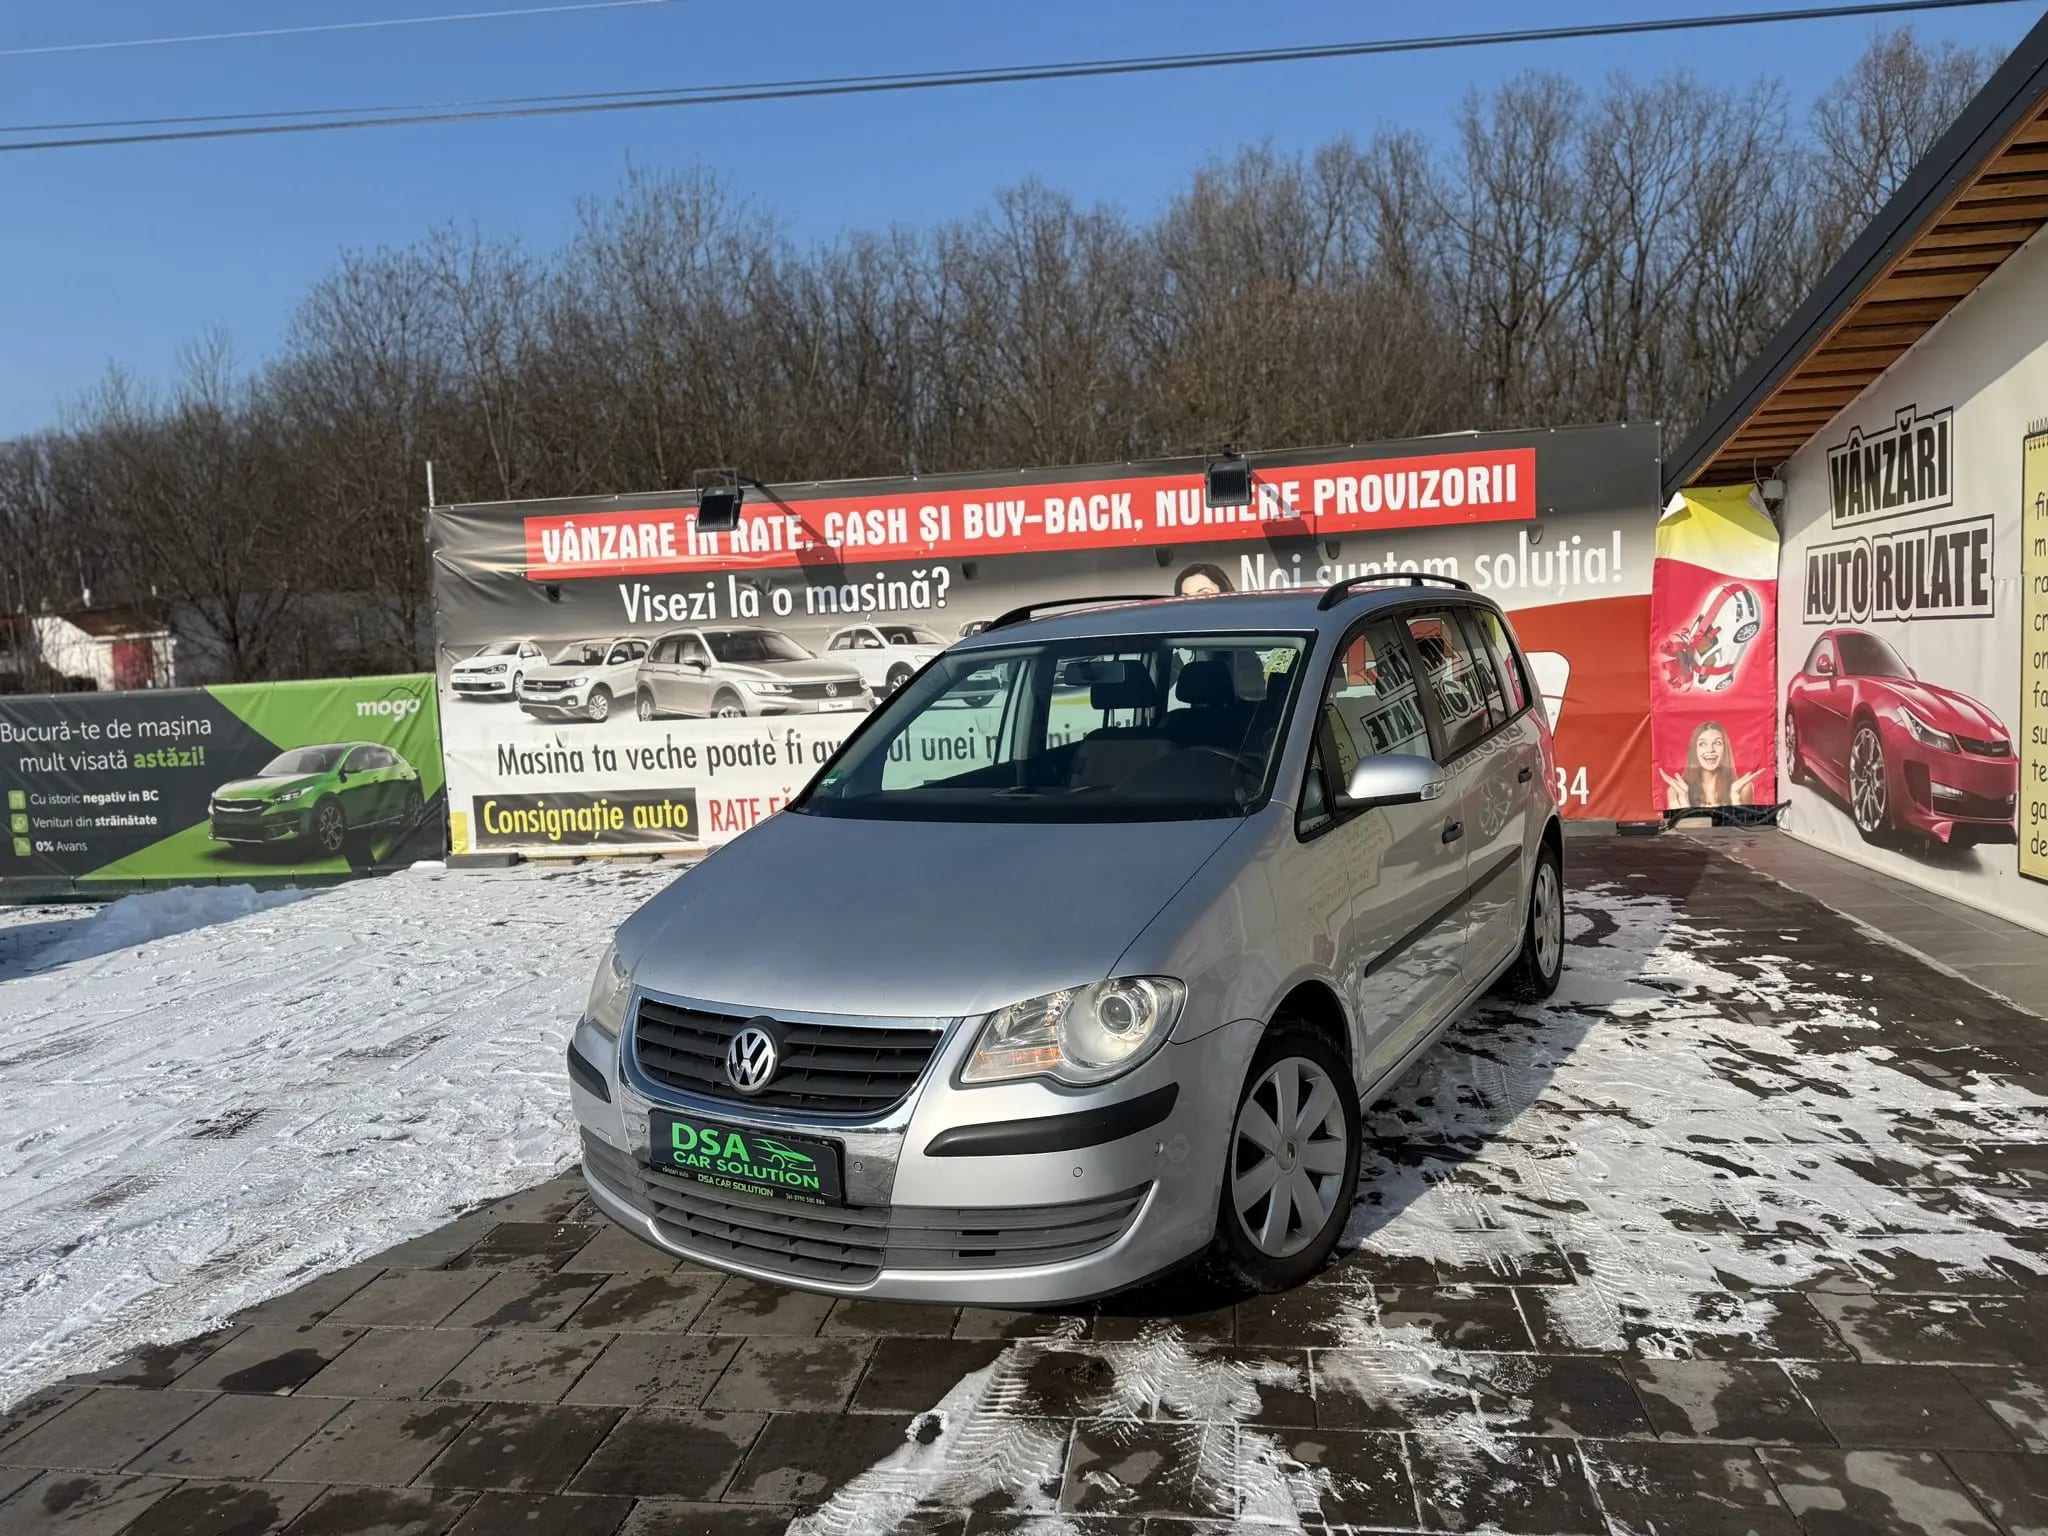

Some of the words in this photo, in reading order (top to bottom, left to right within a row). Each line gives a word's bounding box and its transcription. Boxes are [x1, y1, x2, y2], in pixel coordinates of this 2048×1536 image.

[1831, 417, 1948, 519] VÂNZĂRI
[542, 521, 677, 563] VÂNZARE
[823, 508, 907, 548] CASH
[920, 505, 950, 551] ȘI
[963, 492, 1143, 541] BUY-BACK,
[1314, 463, 1517, 517] PROVIZORII
[1475, 530, 1622, 597] soluția!
[1806, 547, 1870, 616] AUTO
[1876, 528, 1989, 612] RULATE
[619, 581, 717, 624] Visezi
[728, 574, 760, 619] la
[772, 587, 793, 616] o
[806, 566, 951, 622] mașină?
[1, 721, 100, 743] Bucură-te
[106, 719, 132, 738] de
[138, 715, 212, 741] mașina
[356, 698, 421, 722] mogo
[20, 753, 67, 773] mult
[70, 750, 128, 770] visată
[133, 746, 205, 769] astăzi!
[592, 743, 619, 772] ta
[630, 734, 697, 770] veche
[707, 738, 777, 776] poate
[786, 728, 803, 765] fi
[30, 793, 46, 805] Cu
[48, 792, 81, 804] istoric
[83, 791, 126, 805] negativ
[142, 790, 160, 801] BC
[32, 816, 73, 828] Venituri
[75, 815, 93, 828] din
[95, 814, 158, 827] străinătate
[483, 799, 625, 840] Consignație
[632, 798, 690, 831] auto
[35, 840, 55, 852] 0%
[56, 840, 88, 852] Avans
[671, 1122, 751, 1162] DSA
[673, 1151, 712, 1169] CAR
[716, 1158, 820, 1190] SOLUTION
[697, 1173, 715, 1185] DSA
[715, 1179, 733, 1189] CAR
[732, 1182, 774, 1197] SOLUTION
